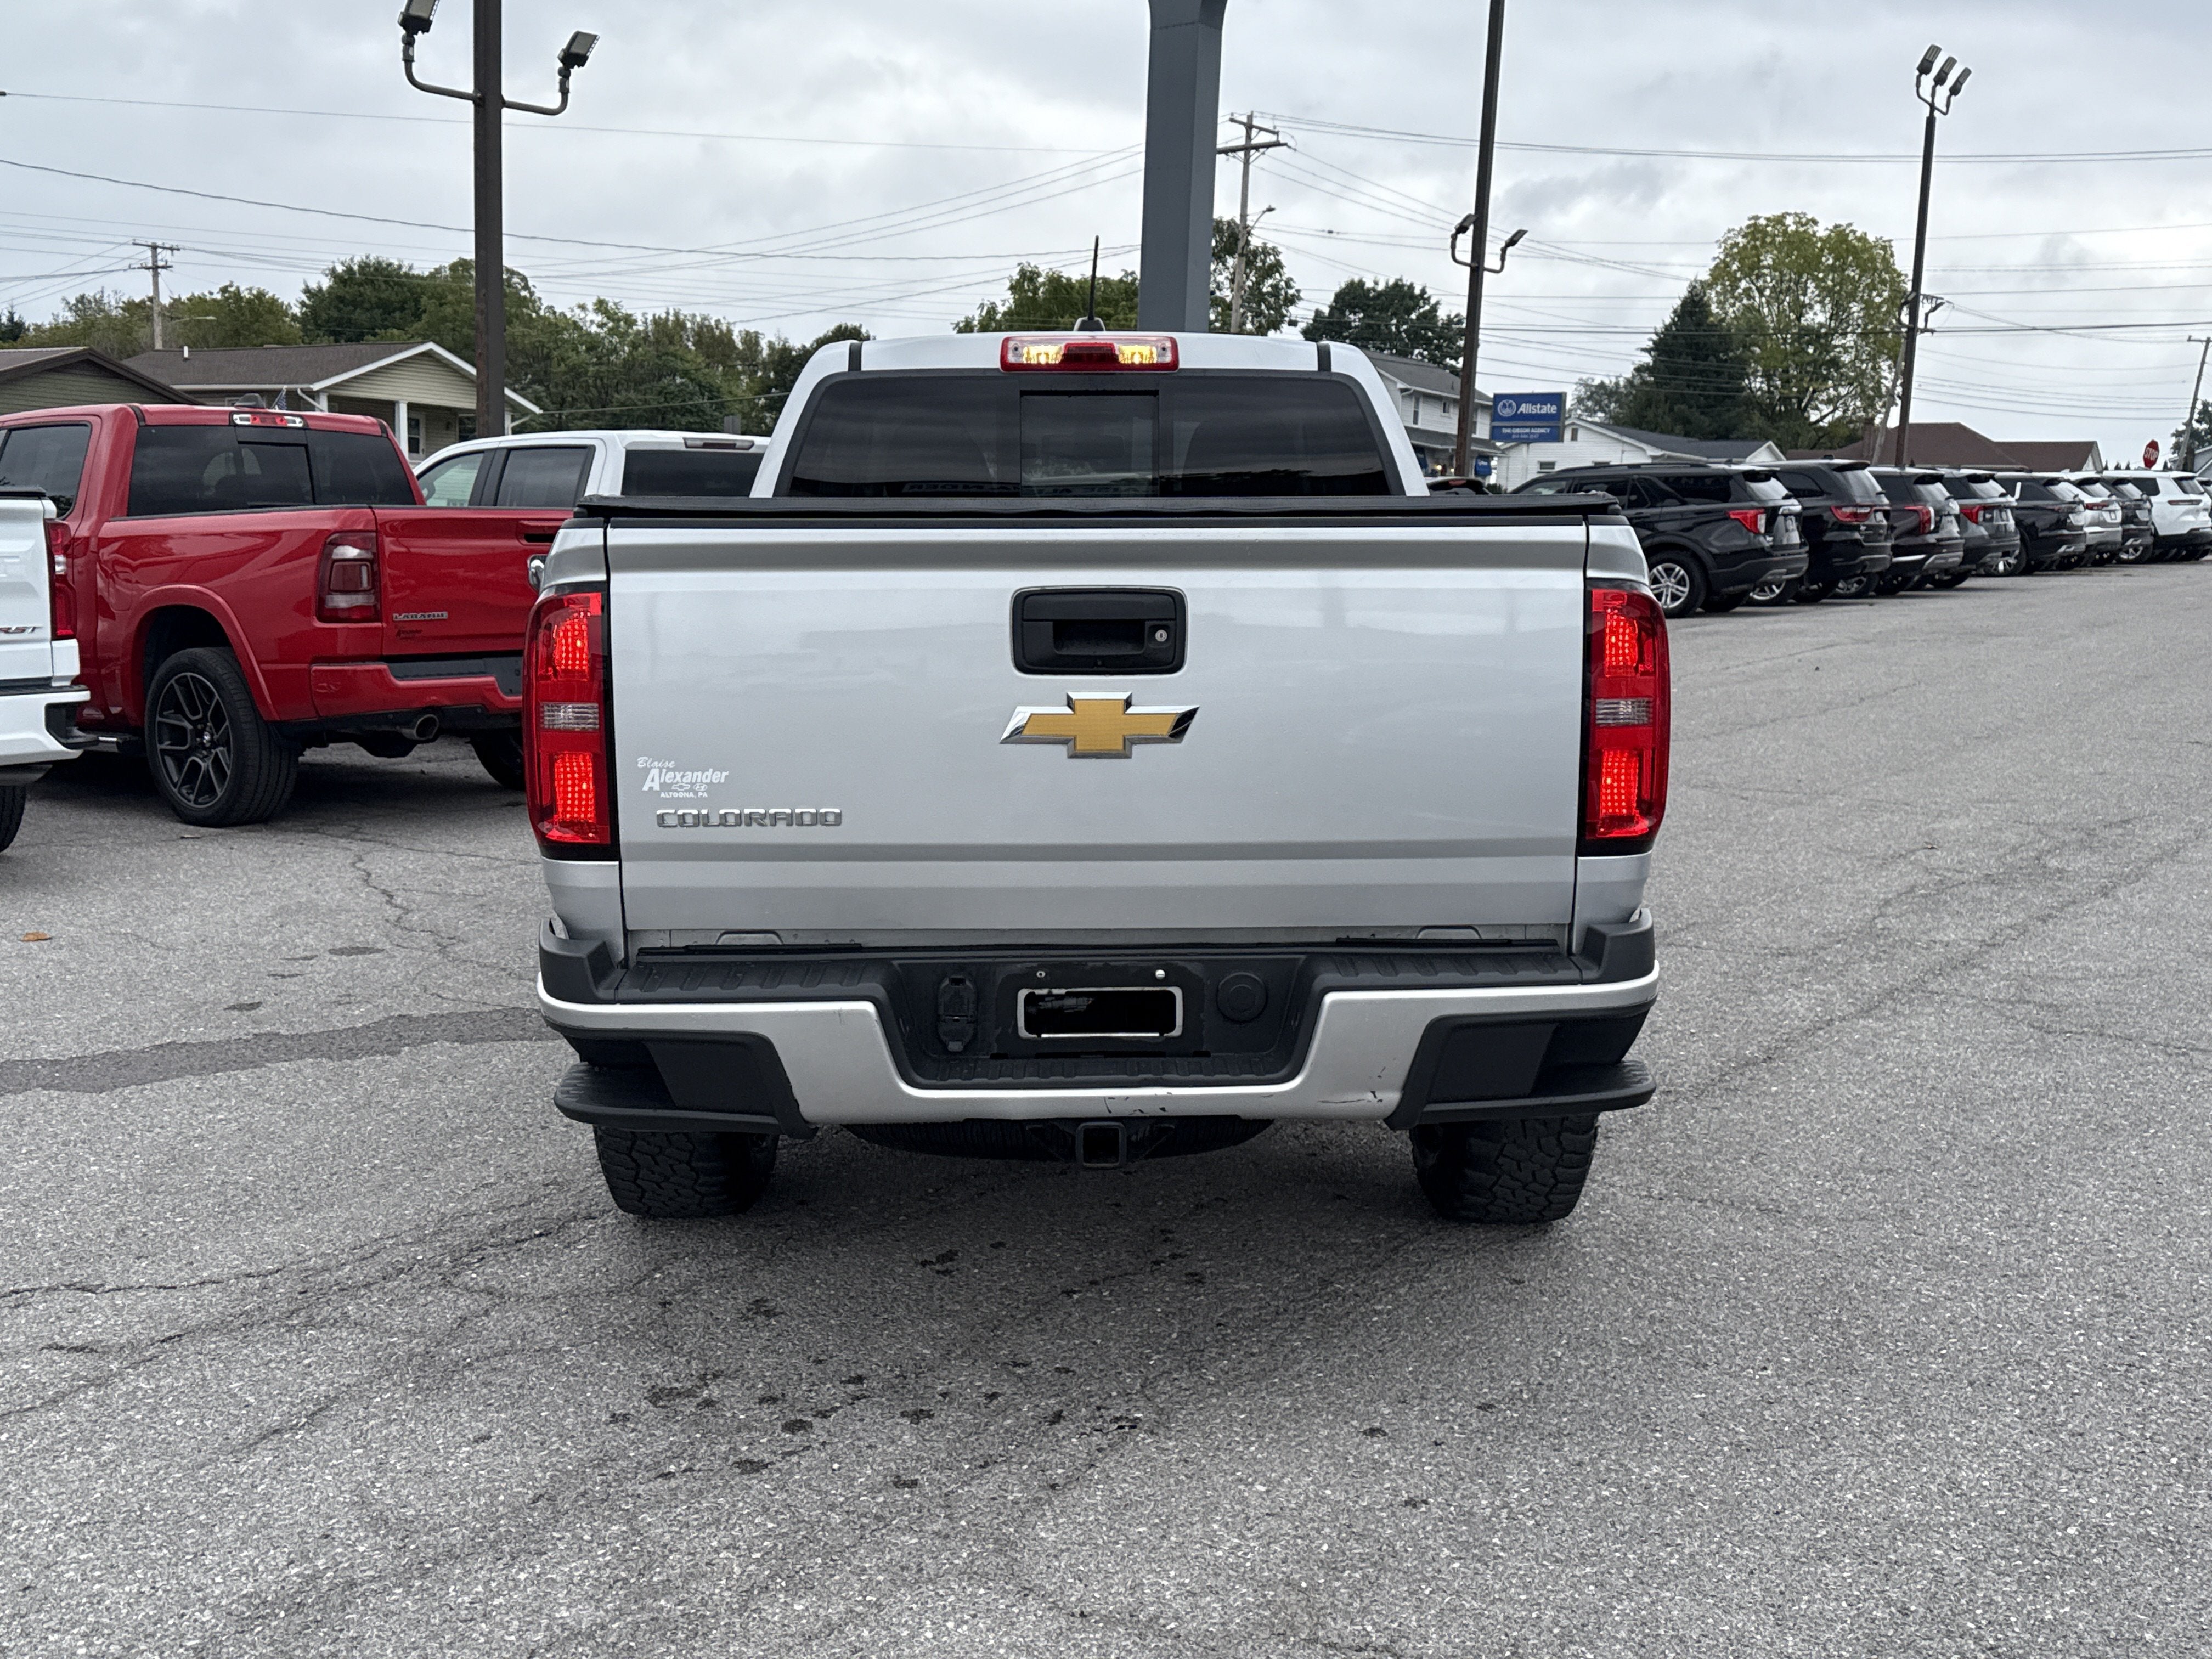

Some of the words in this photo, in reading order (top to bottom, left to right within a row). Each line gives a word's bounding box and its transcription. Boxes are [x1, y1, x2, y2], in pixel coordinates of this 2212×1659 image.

[1517, 403, 1558, 414] Allstate
[2145, 447, 2159, 461] STOP
[636, 757, 675, 768] Blaise
[642, 768, 729, 791] Alexander
[656, 808, 842, 827] COLORADO
